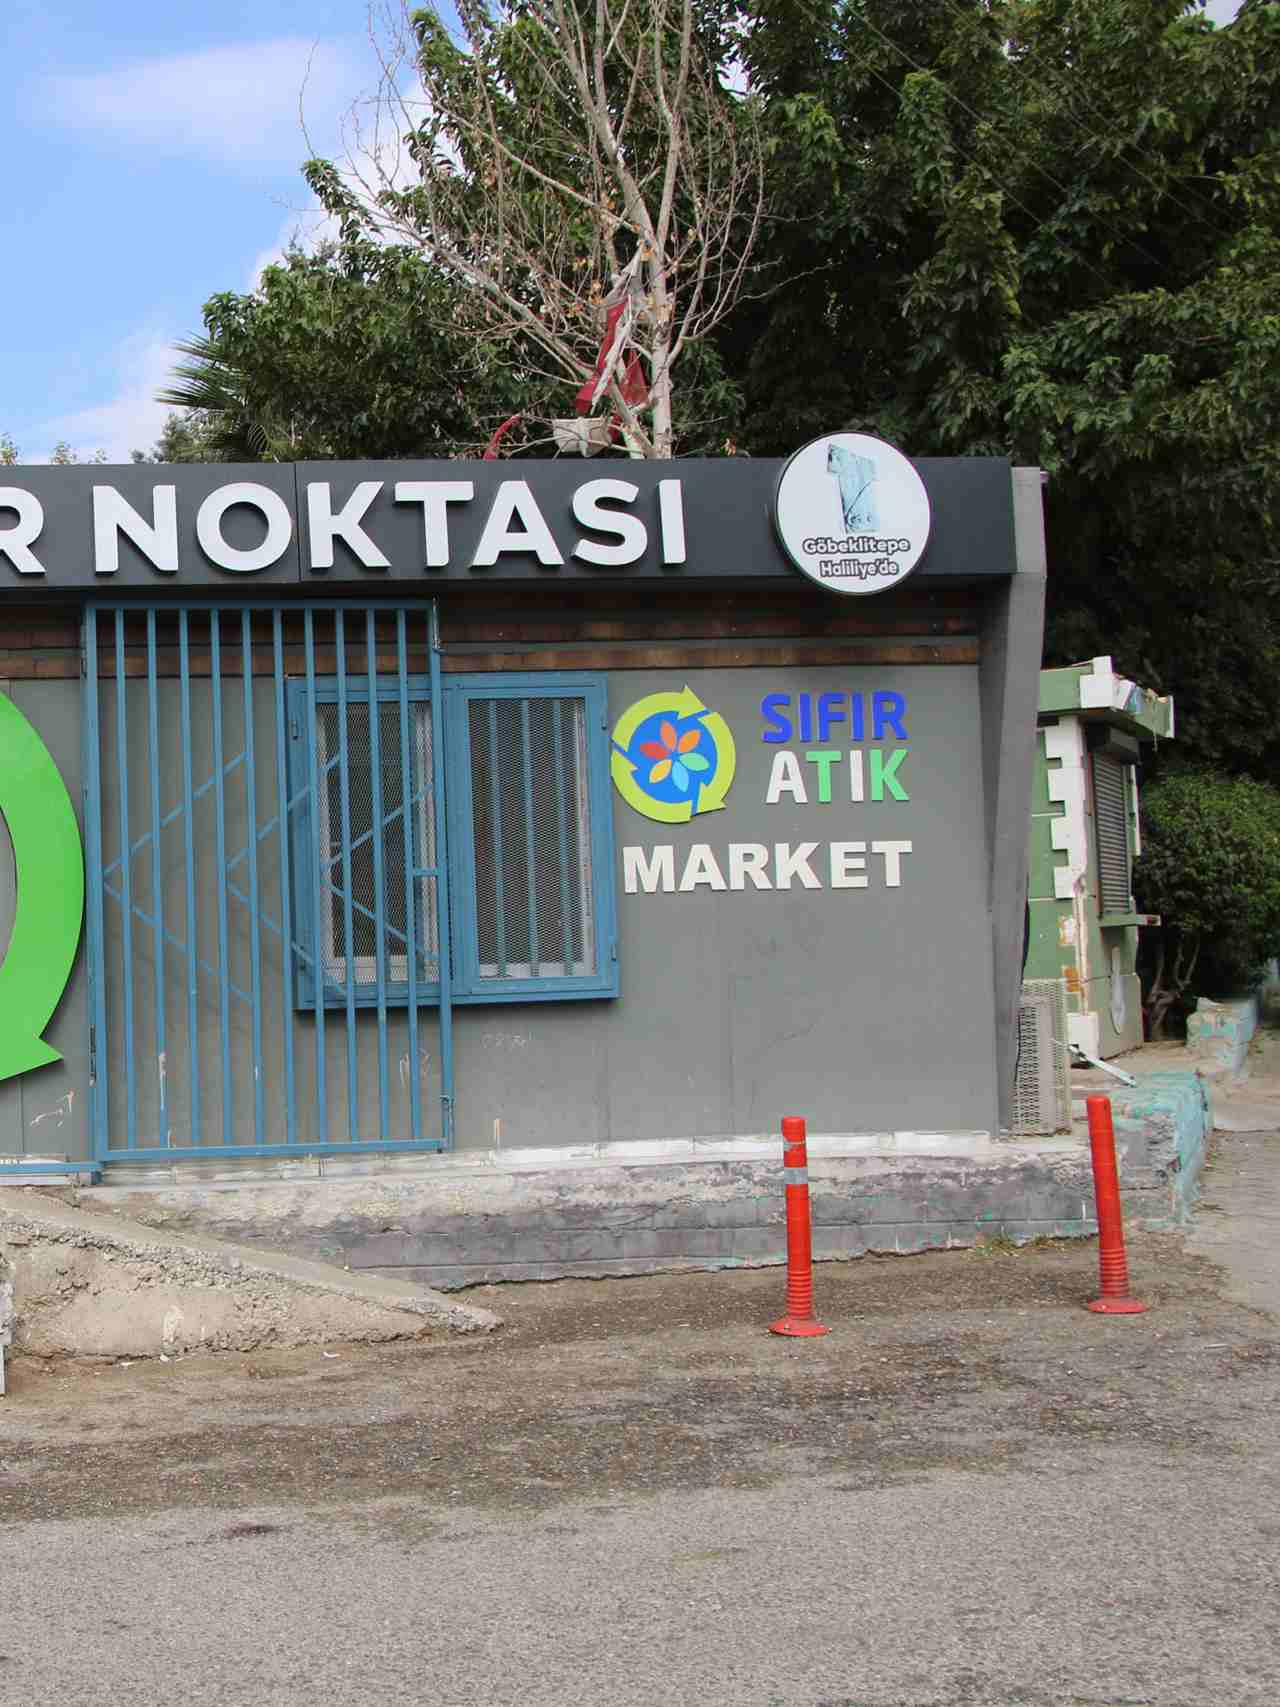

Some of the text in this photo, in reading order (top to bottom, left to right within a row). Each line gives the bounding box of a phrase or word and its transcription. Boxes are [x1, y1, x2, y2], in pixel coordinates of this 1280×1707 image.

[92, 478, 688, 573] NOKTASI
[802, 536, 911, 555] Göbeklitepe
[819, 558, 899, 580] Haliliye'de
[760, 690, 908, 744] SIFIR
[765, 749, 910, 804] ATIK
[622, 840, 913, 895] MARKET
